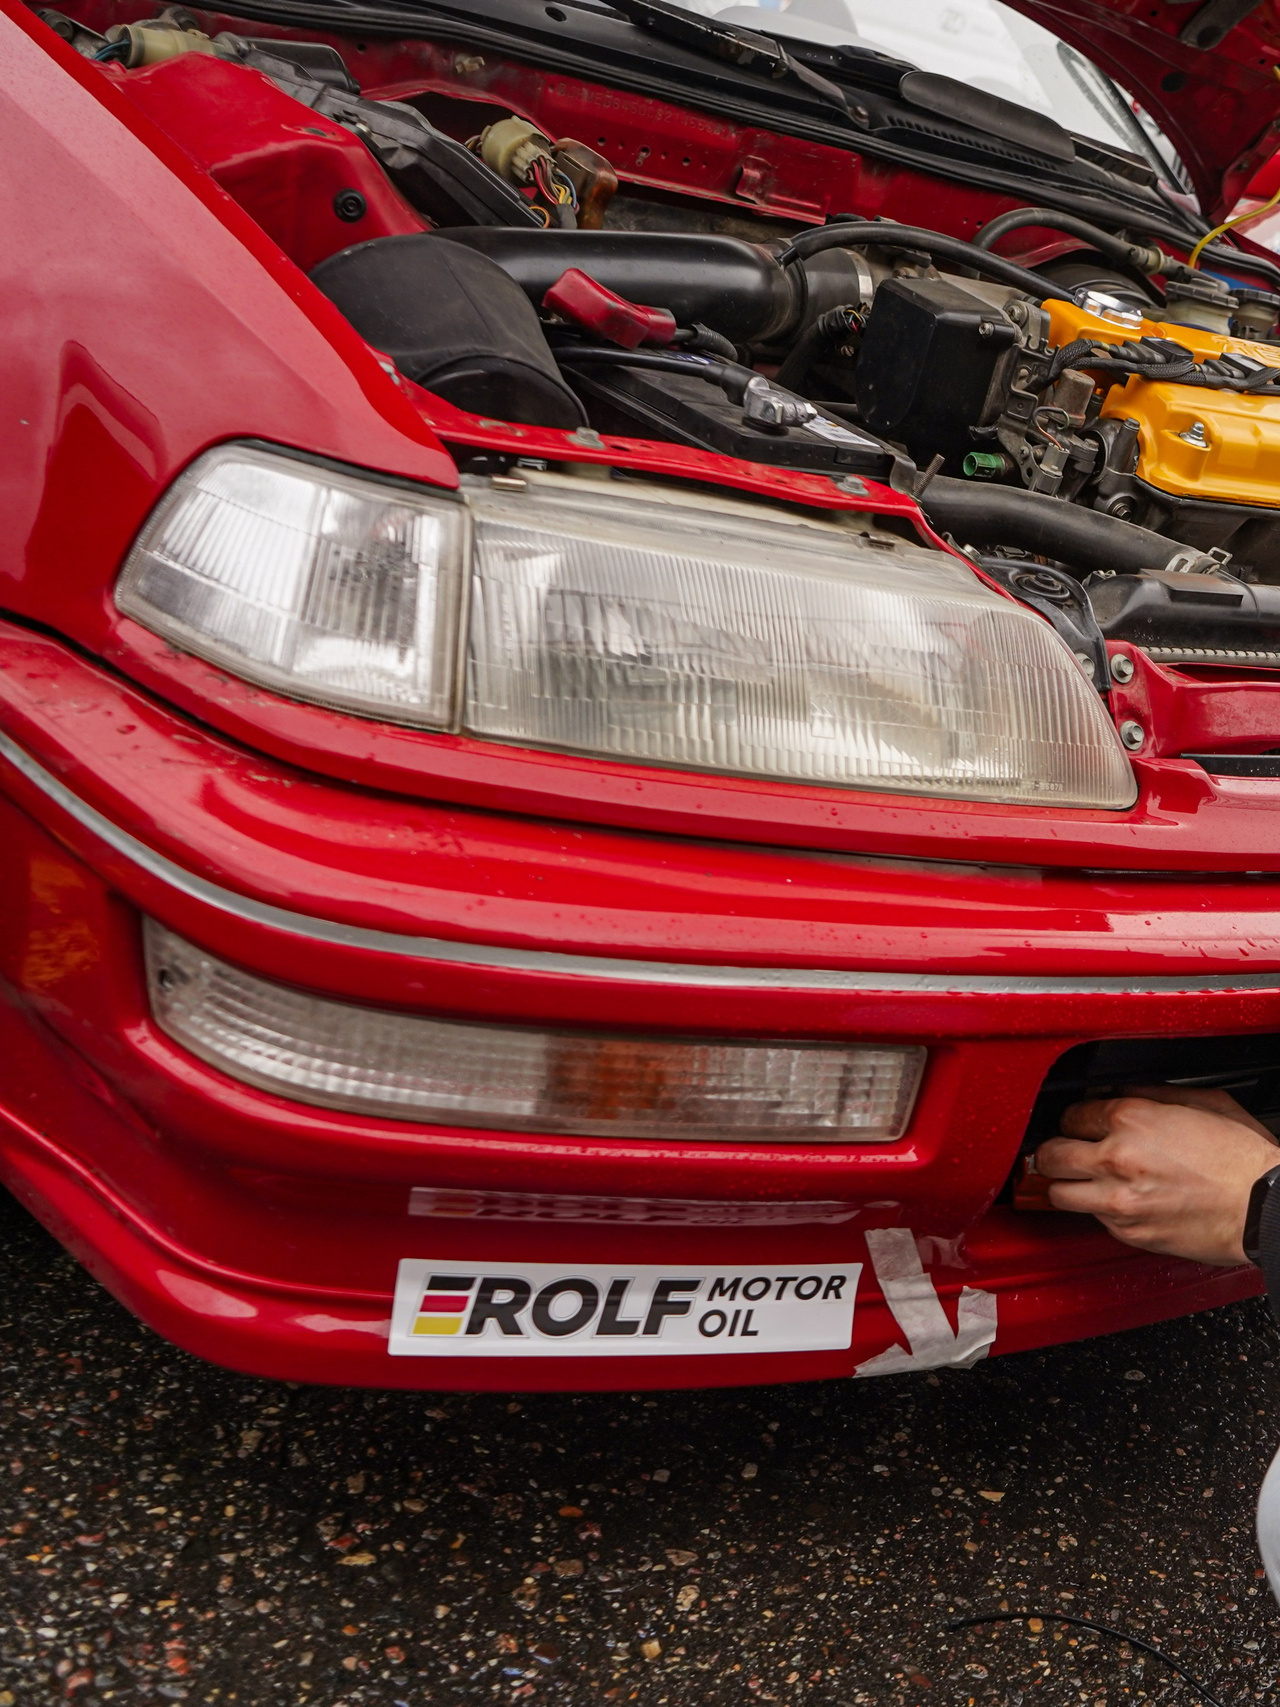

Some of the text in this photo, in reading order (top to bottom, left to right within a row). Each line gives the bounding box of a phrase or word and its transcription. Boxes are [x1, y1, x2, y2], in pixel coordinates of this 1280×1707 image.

[708, 1276, 847, 1302] MOTOR
[465, 1276, 701, 1336] ROLF
[699, 1309, 759, 1337] OIL
